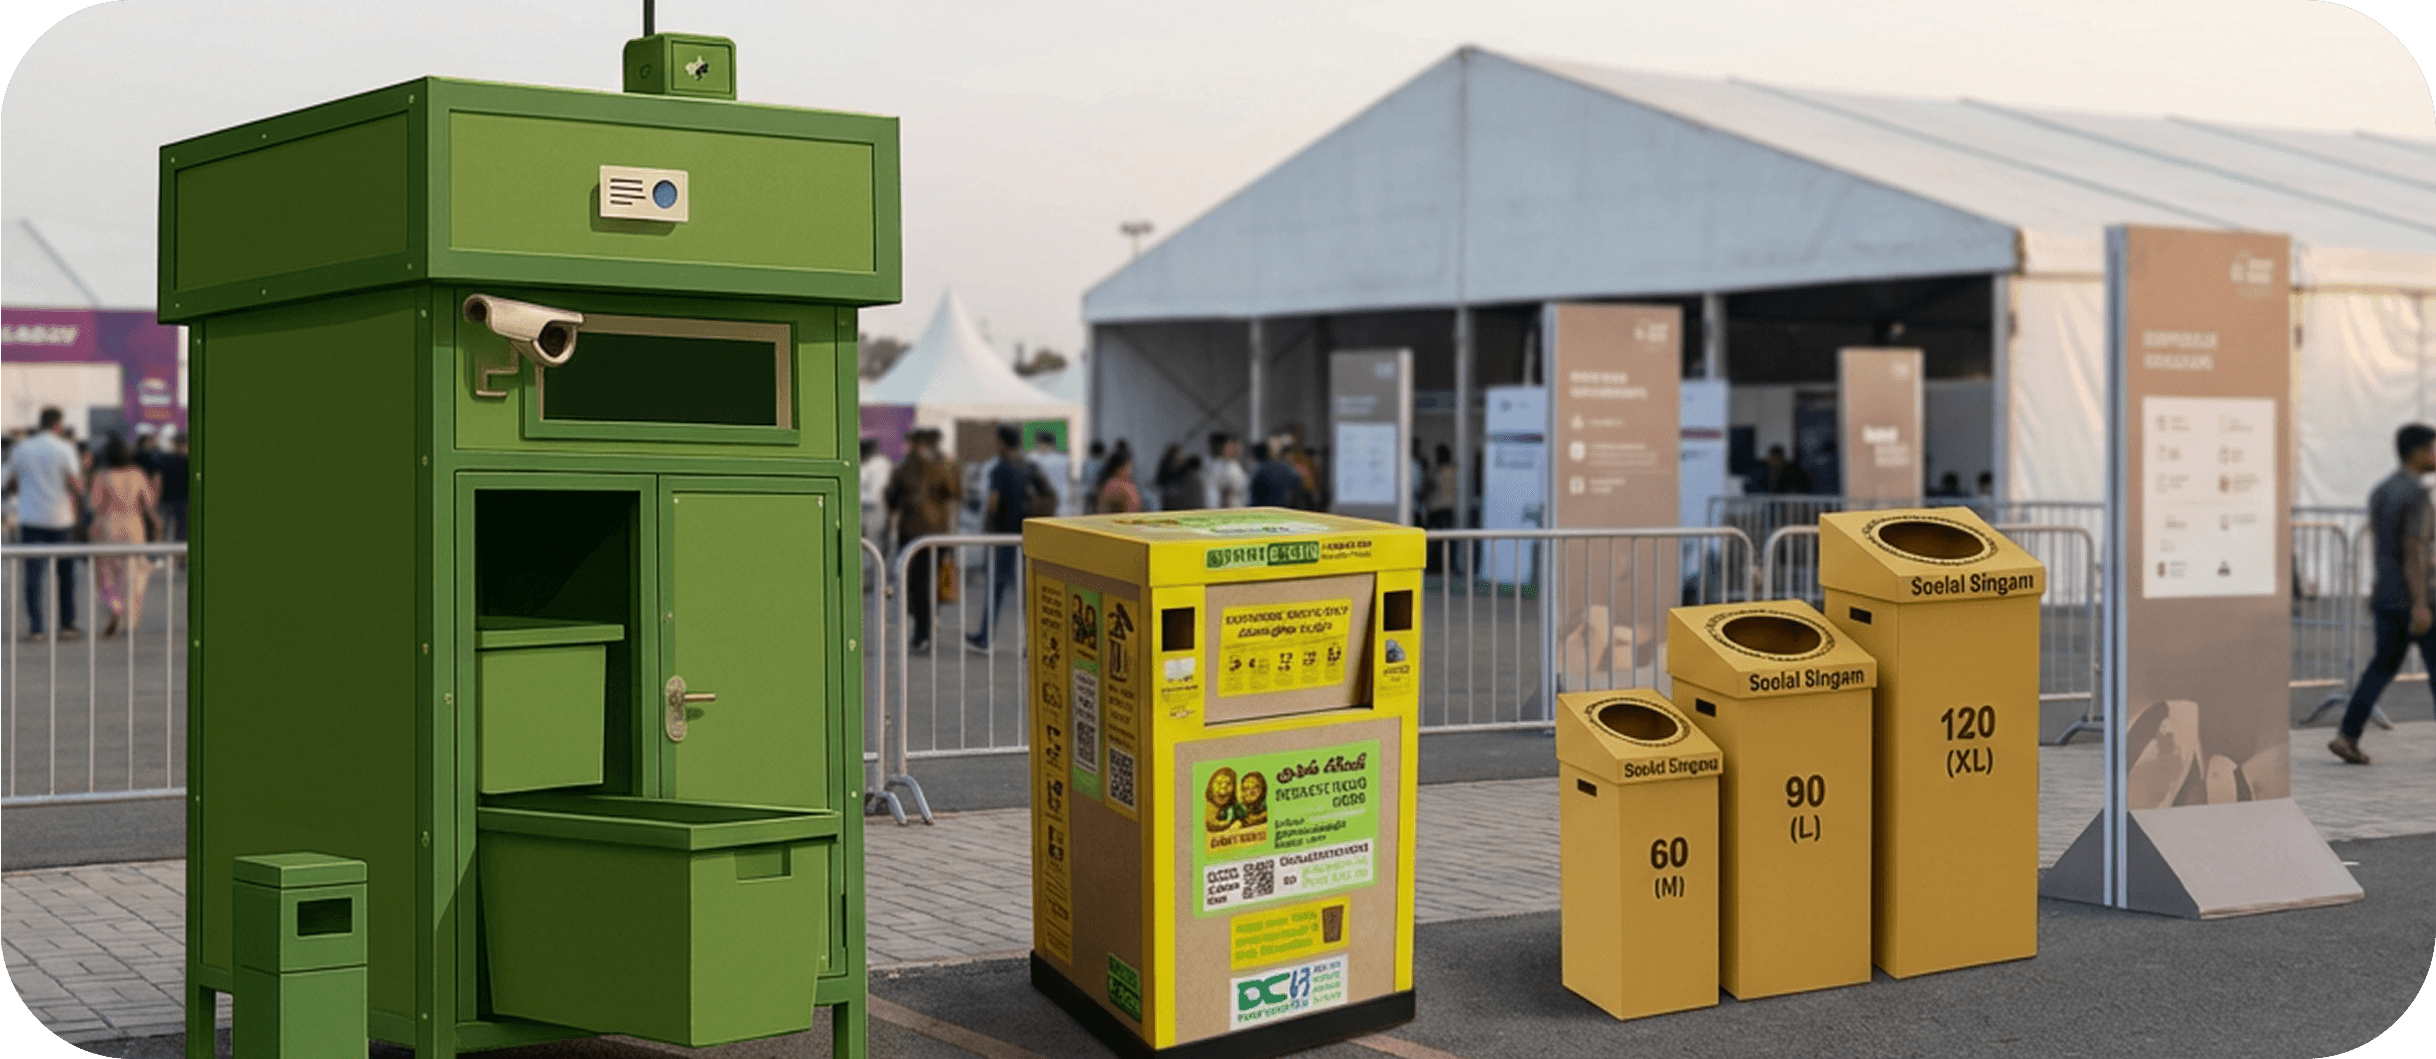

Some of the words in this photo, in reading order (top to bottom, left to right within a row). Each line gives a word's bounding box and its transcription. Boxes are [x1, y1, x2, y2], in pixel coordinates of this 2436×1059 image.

[1941, 705, 1995, 741] 120
[1946, 747, 1993, 778] (XL)
[1785, 774, 1825, 808] 90
[1790, 815, 1821, 843] (L)
[1651, 836, 1688, 869] 60
[1654, 875, 1685, 899] (M)
